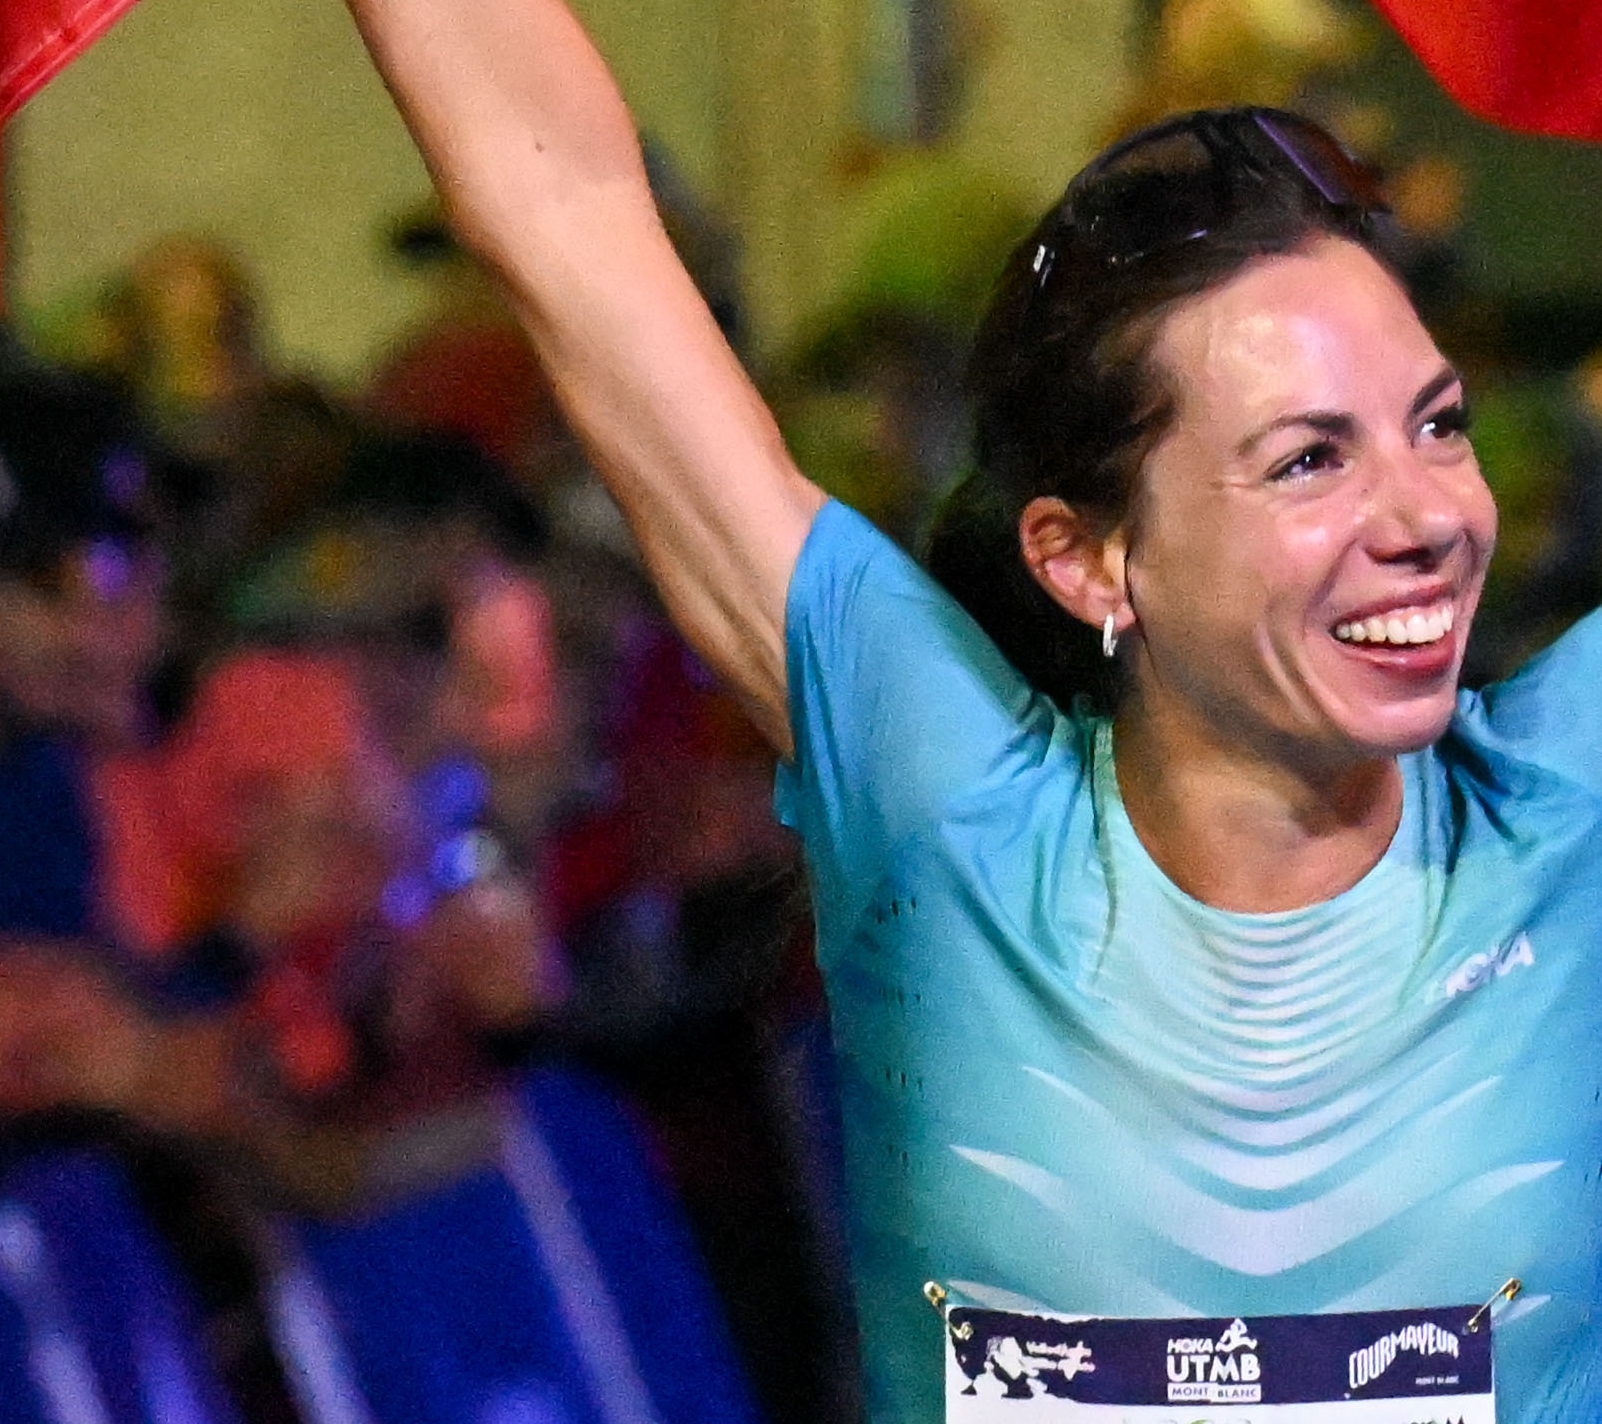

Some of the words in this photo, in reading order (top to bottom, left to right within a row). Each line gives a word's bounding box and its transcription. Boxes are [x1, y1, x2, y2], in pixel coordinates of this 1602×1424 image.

[1166, 1338, 1214, 1354] HOKA
[1348, 1321, 1460, 1389] COURMAYEUR
[1166, 1353, 1261, 1383] UTMB
[1171, 1387, 1209, 1397] MONT
[1217, 1388, 1257, 1399] BLANC
